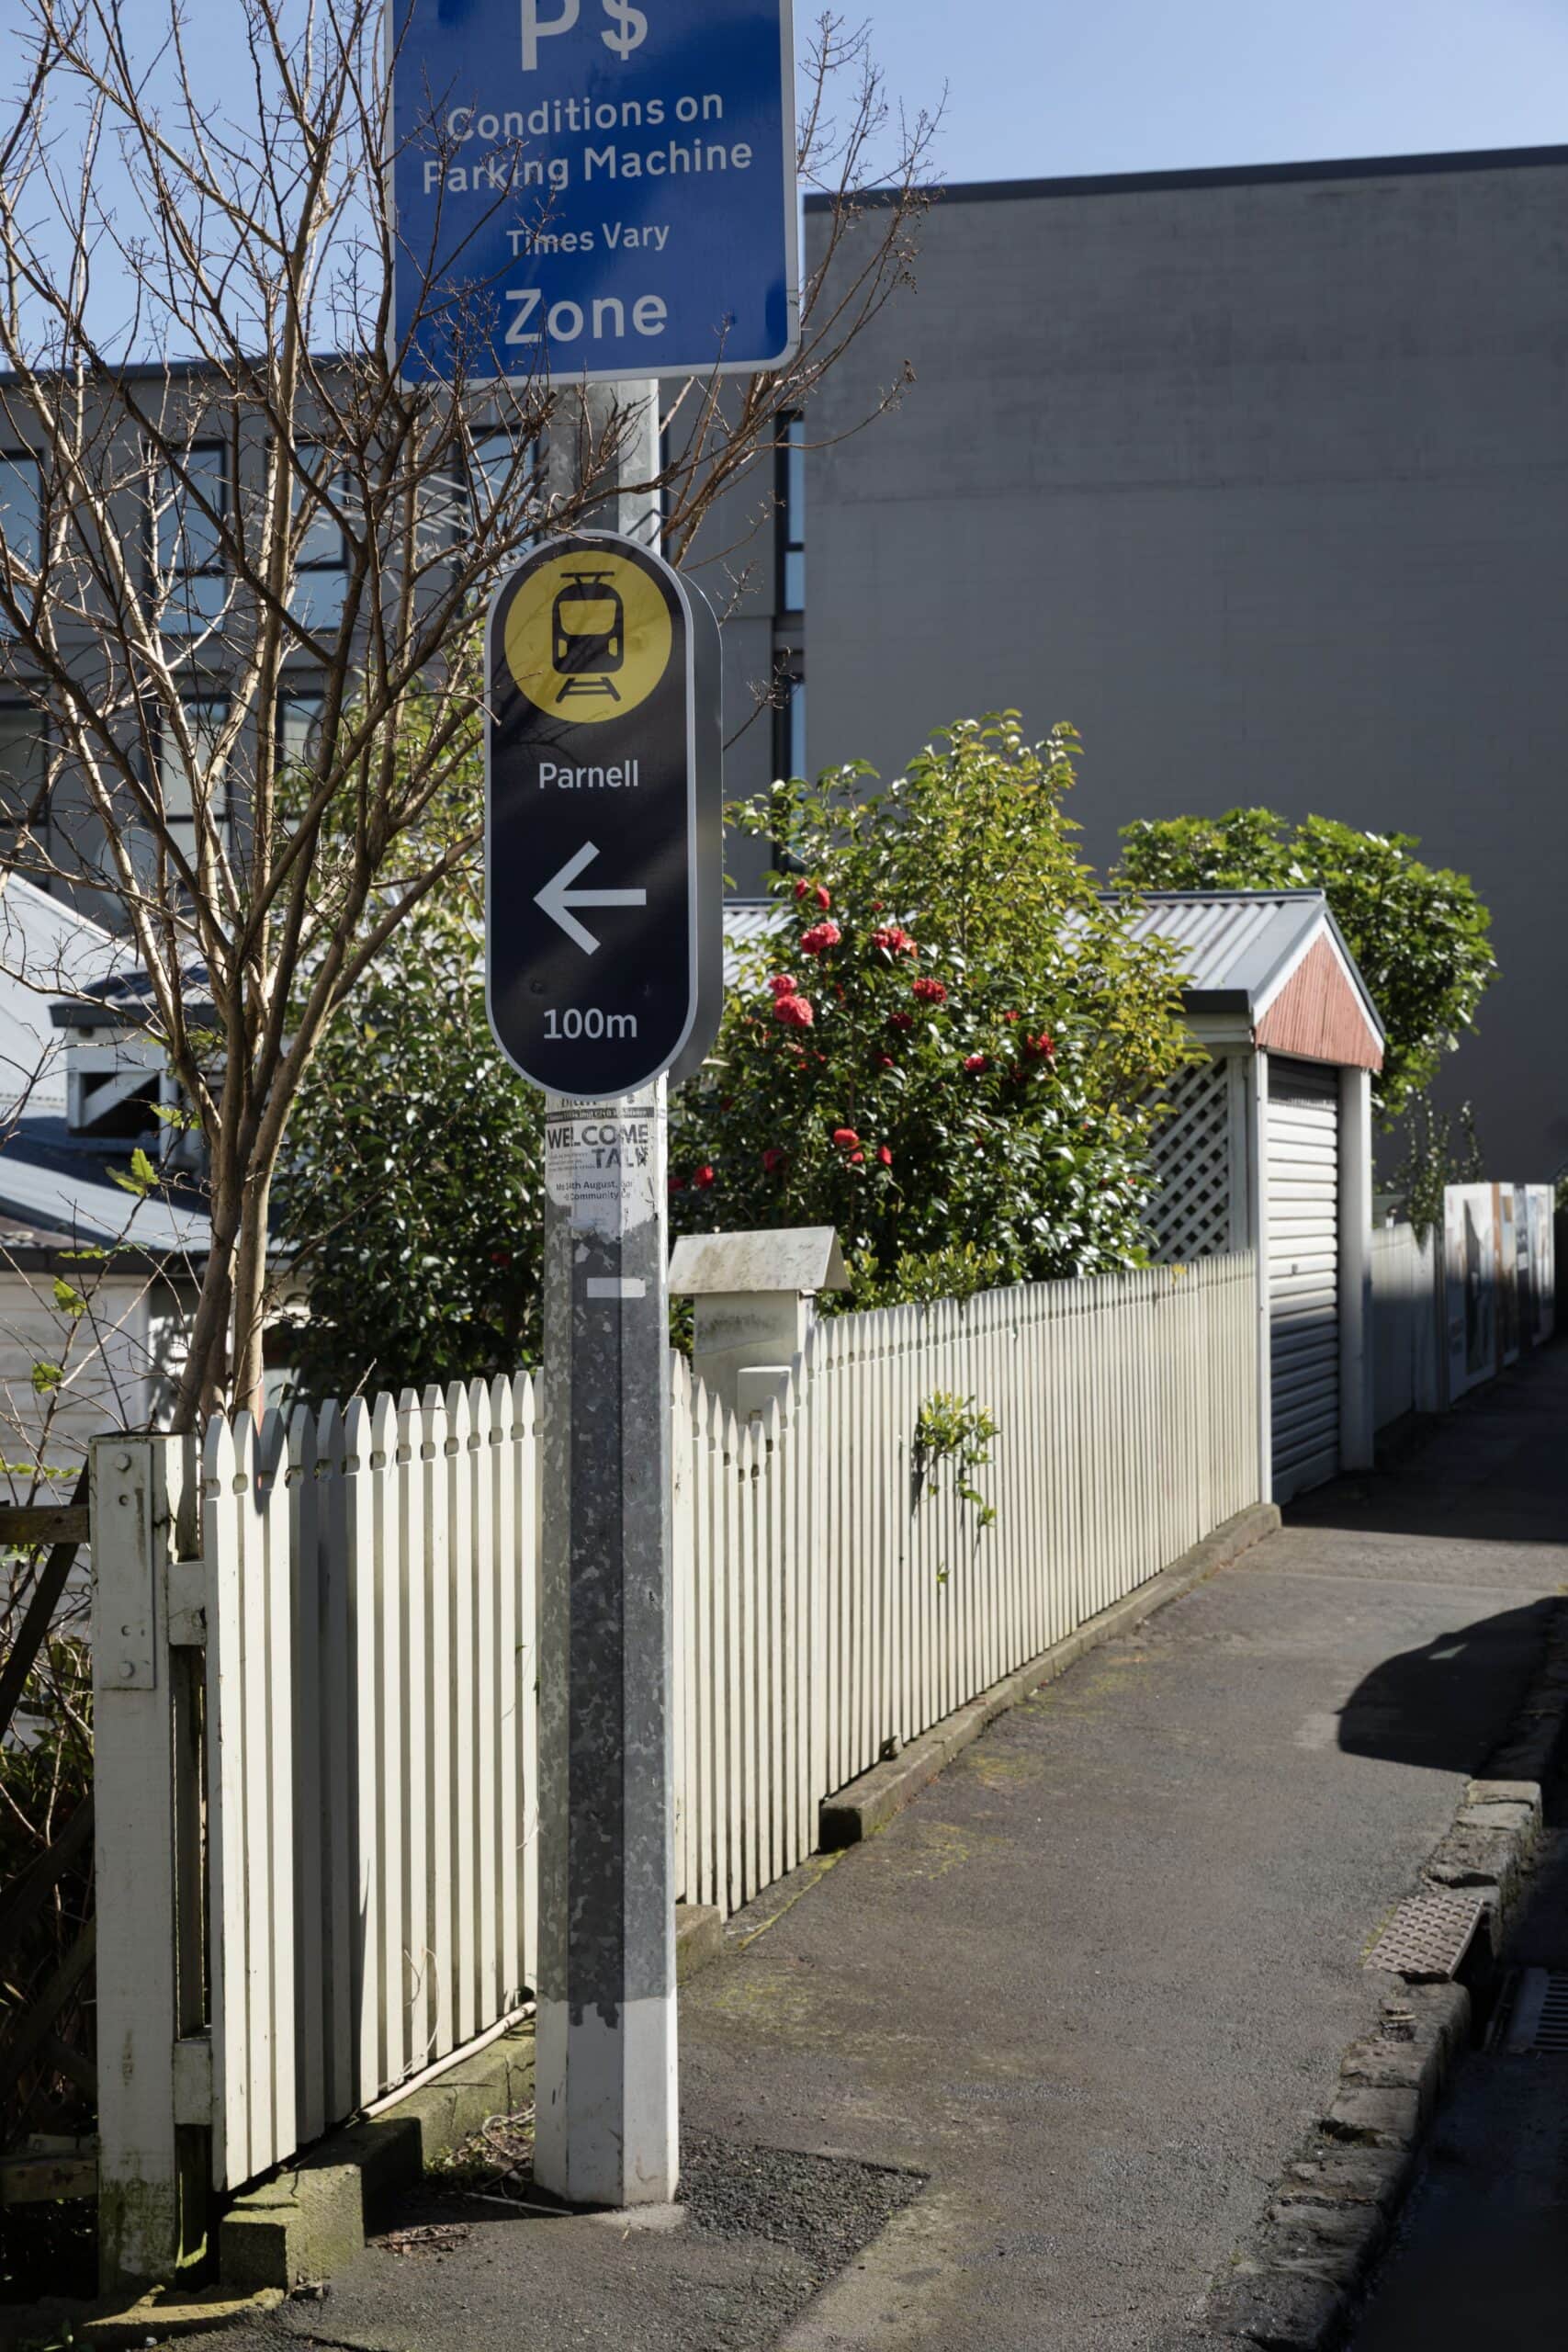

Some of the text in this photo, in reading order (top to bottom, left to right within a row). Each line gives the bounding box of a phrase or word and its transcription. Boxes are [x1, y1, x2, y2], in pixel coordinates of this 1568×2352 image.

[521, 0, 581, 72] P
[446, 93, 724, 142] Conditions on
[423, 138, 753, 195] Parking Machine
[506, 220, 671, 258] Times Vary
[504, 288, 669, 345] Zone
[538, 760, 639, 789] Parnell
[543, 1008, 638, 1040] 100m
[547, 1124, 649, 1149] WELCOME
